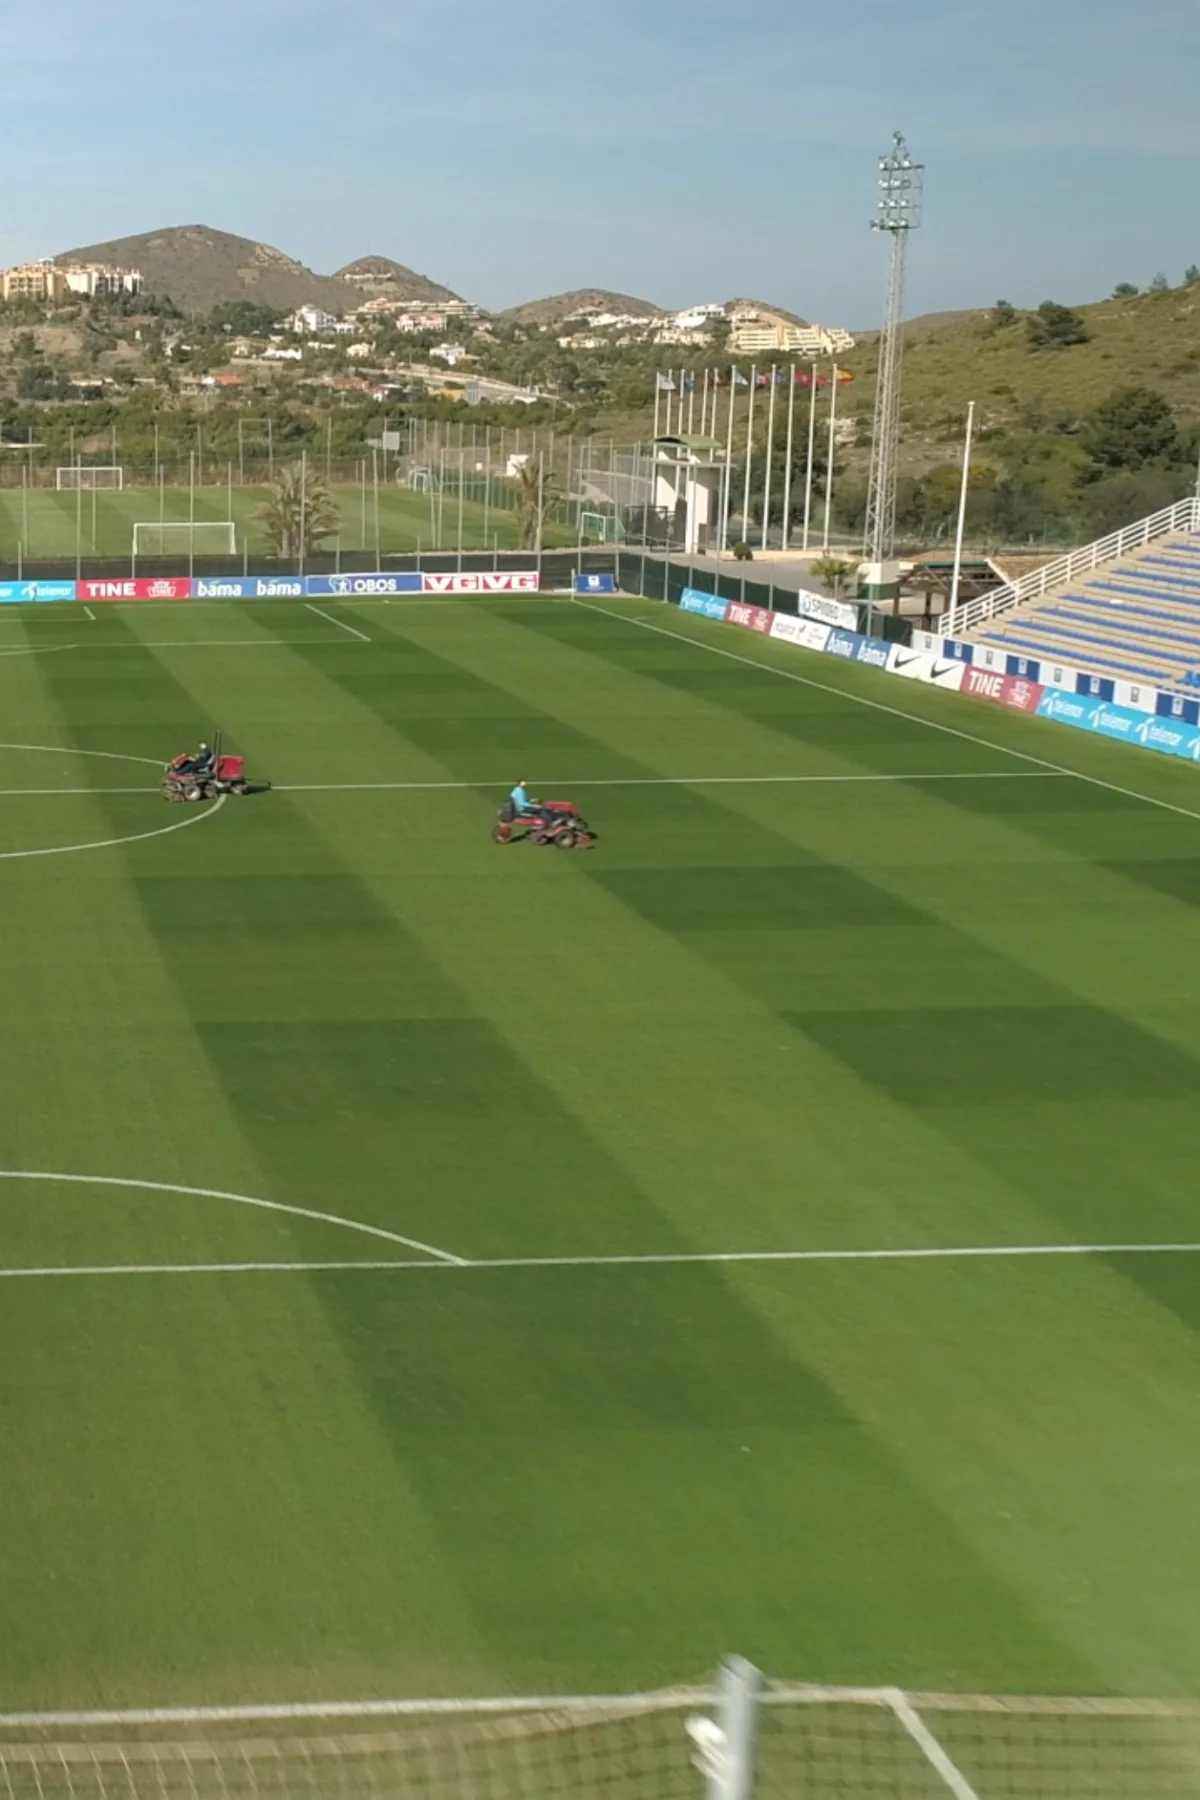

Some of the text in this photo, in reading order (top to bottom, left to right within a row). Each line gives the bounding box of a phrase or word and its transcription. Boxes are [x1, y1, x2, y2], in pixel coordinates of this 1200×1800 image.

[86, 582, 136, 597] TINE
[354, 578, 397, 592] OBOS
[425, 576, 479, 591] VG
[483, 574, 537, 590] VG
[968, 669, 1005, 698] TINE
